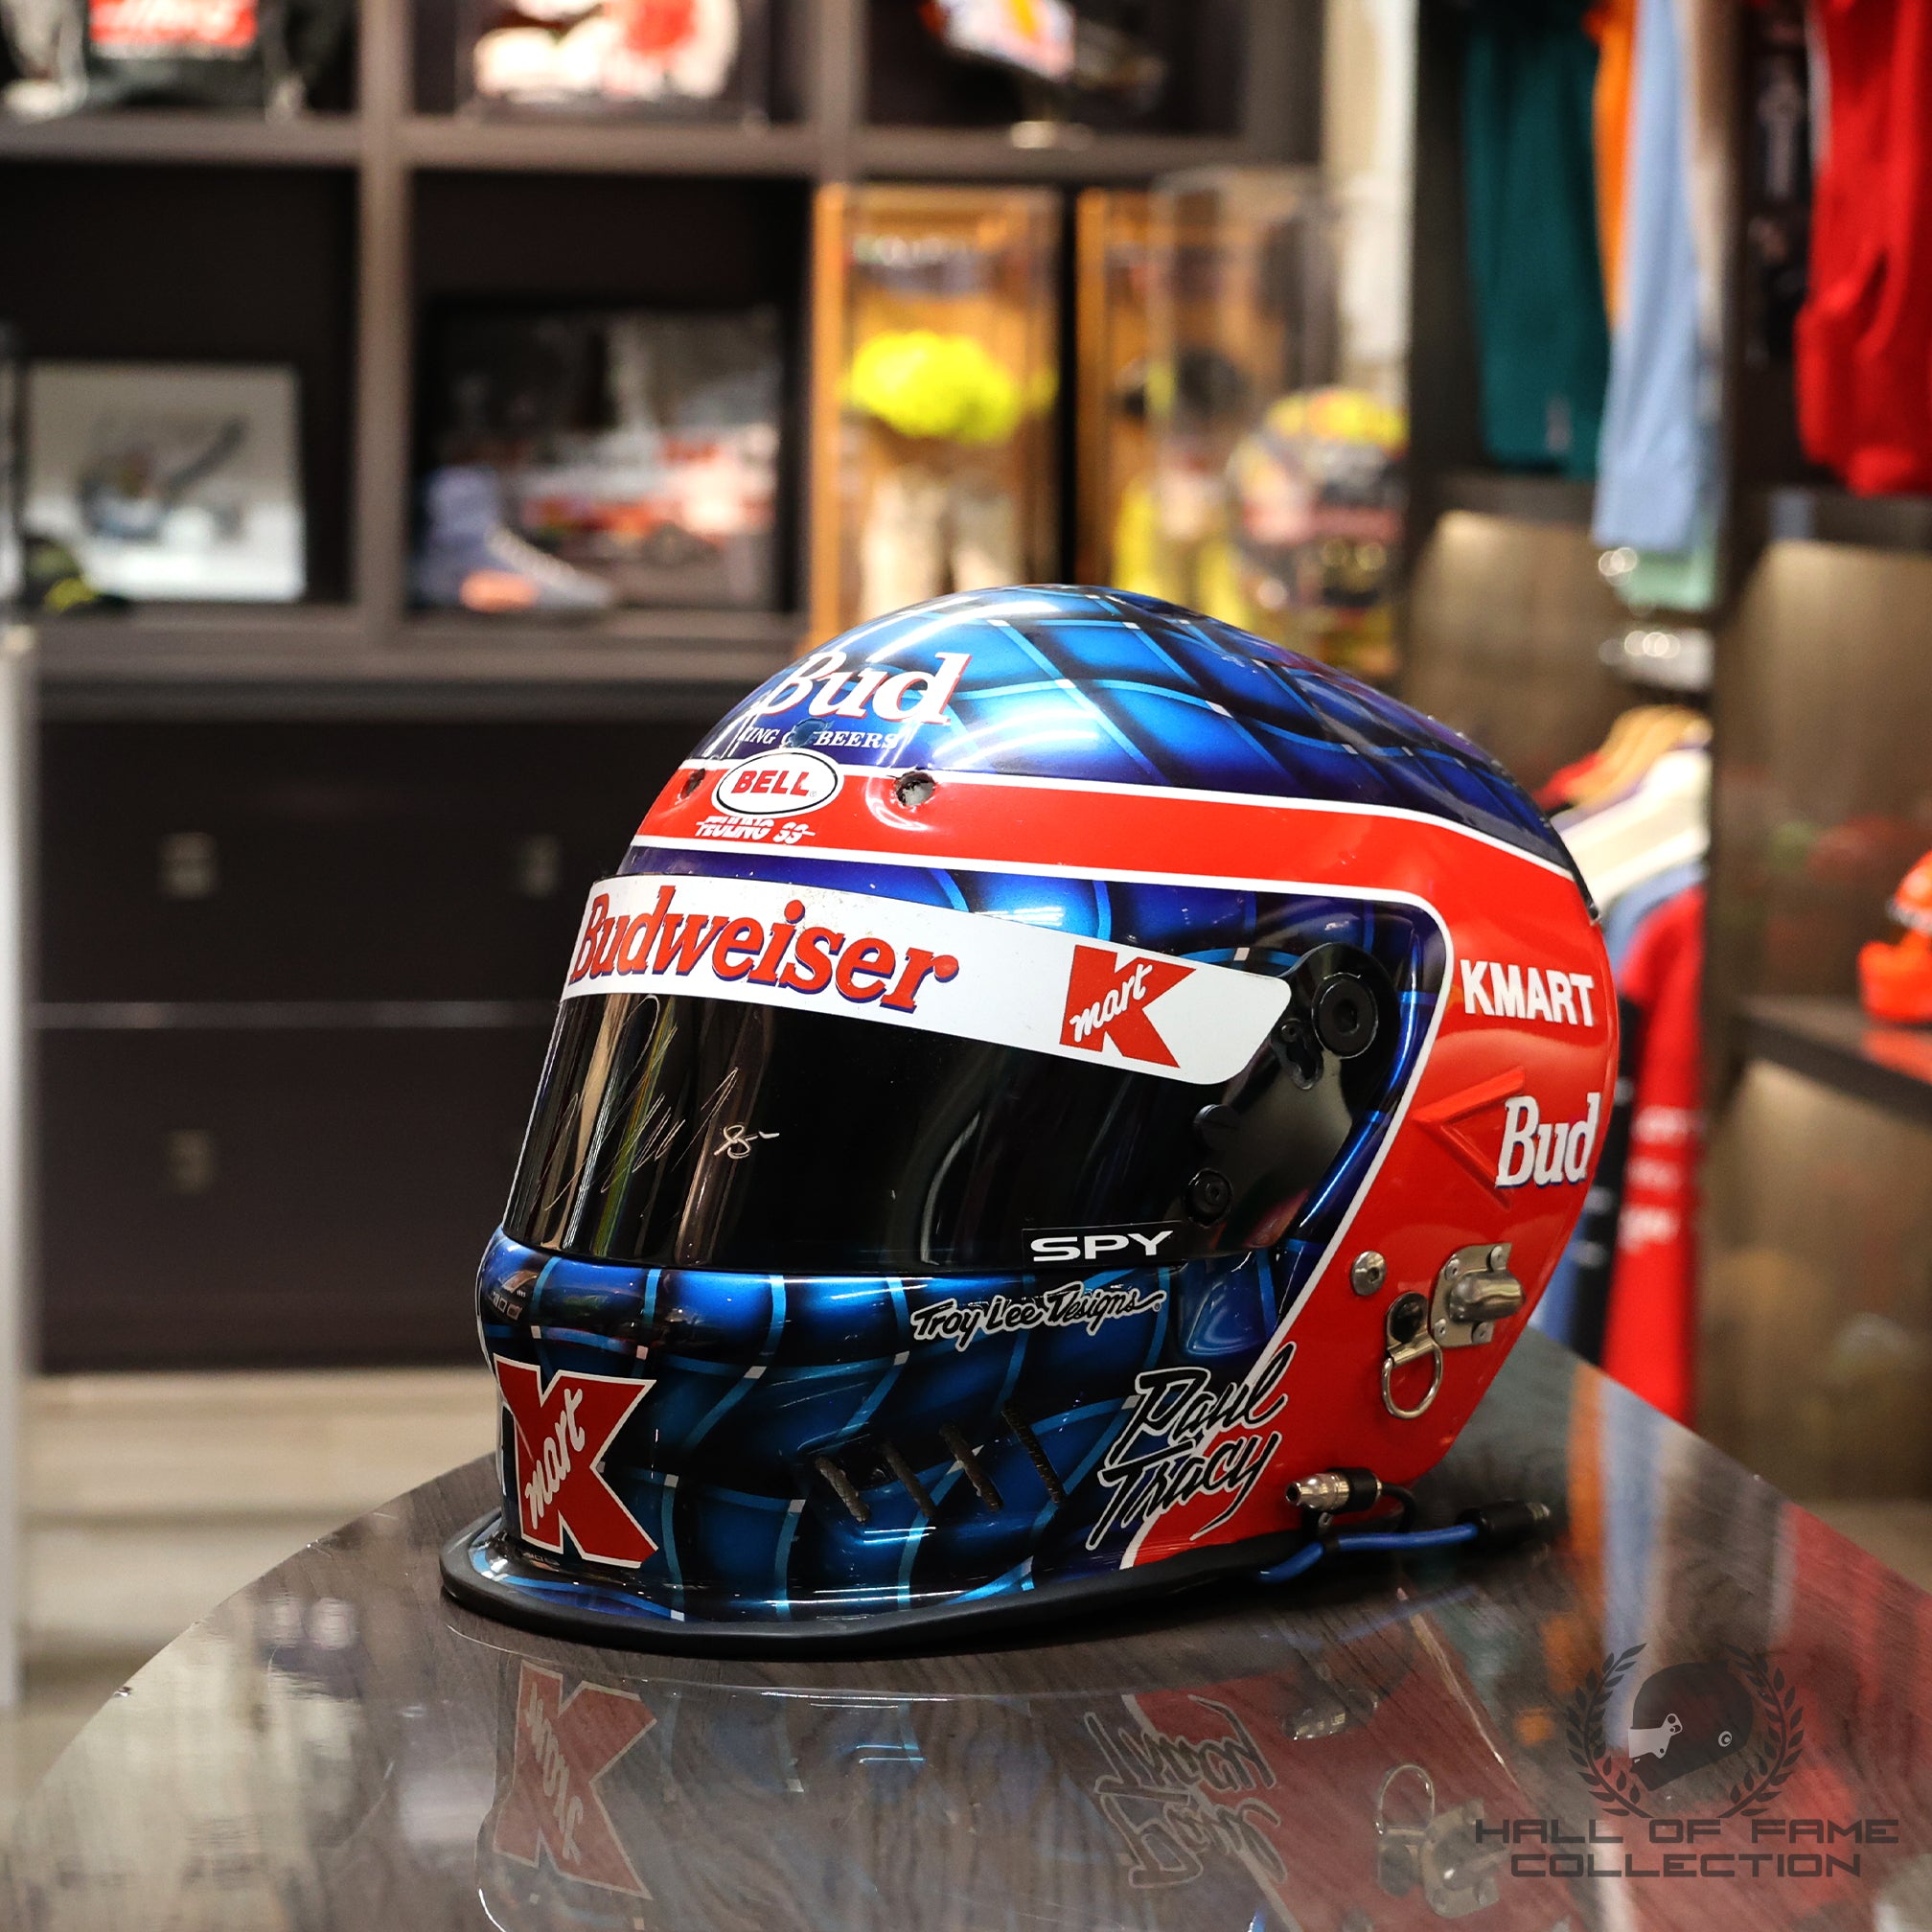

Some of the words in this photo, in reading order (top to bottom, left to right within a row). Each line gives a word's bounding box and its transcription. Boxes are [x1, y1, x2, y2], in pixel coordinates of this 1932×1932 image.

[757, 650, 973, 725] Bud
[813, 730, 898, 750] BEERS
[731, 770, 810, 797] BELL
[568, 886, 959, 1014] Budweiser
[1460, 958, 1596, 1027] KMART
[1494, 1092, 1602, 1190] Bud
[1030, 1230, 1174, 1262] SPY
[910, 1299, 982, 1352] Troy
[982, 1295, 1045, 1334] Lee
[1043, 1280, 1167, 1336] Designs
[1104, 1342, 1298, 1470] Paul
[1085, 1432, 1282, 1551] Tracy
